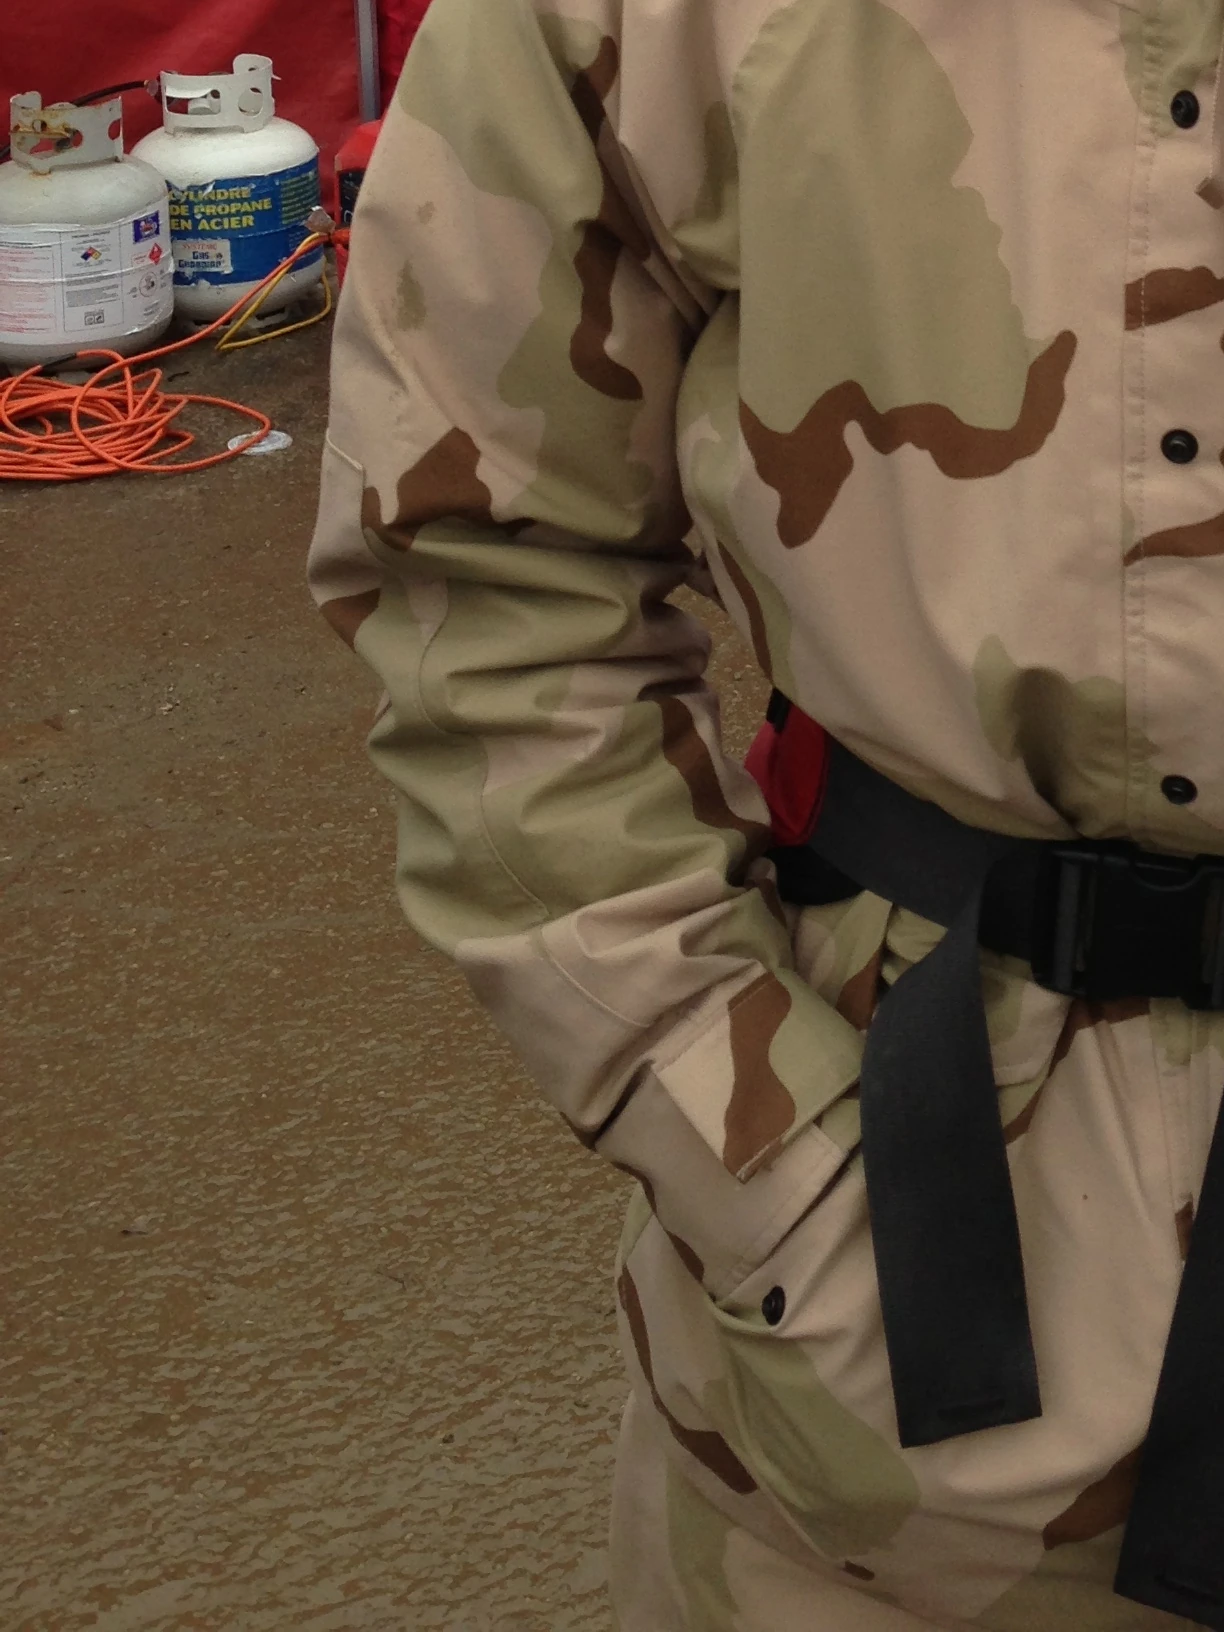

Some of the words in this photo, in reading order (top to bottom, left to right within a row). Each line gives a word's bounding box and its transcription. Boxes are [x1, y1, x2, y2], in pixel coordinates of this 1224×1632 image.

[169, 204, 189, 216] DE
[194, 197, 272, 216] PROPANE
[170, 218, 193, 230] EN
[198, 214, 255, 230] ACIER
